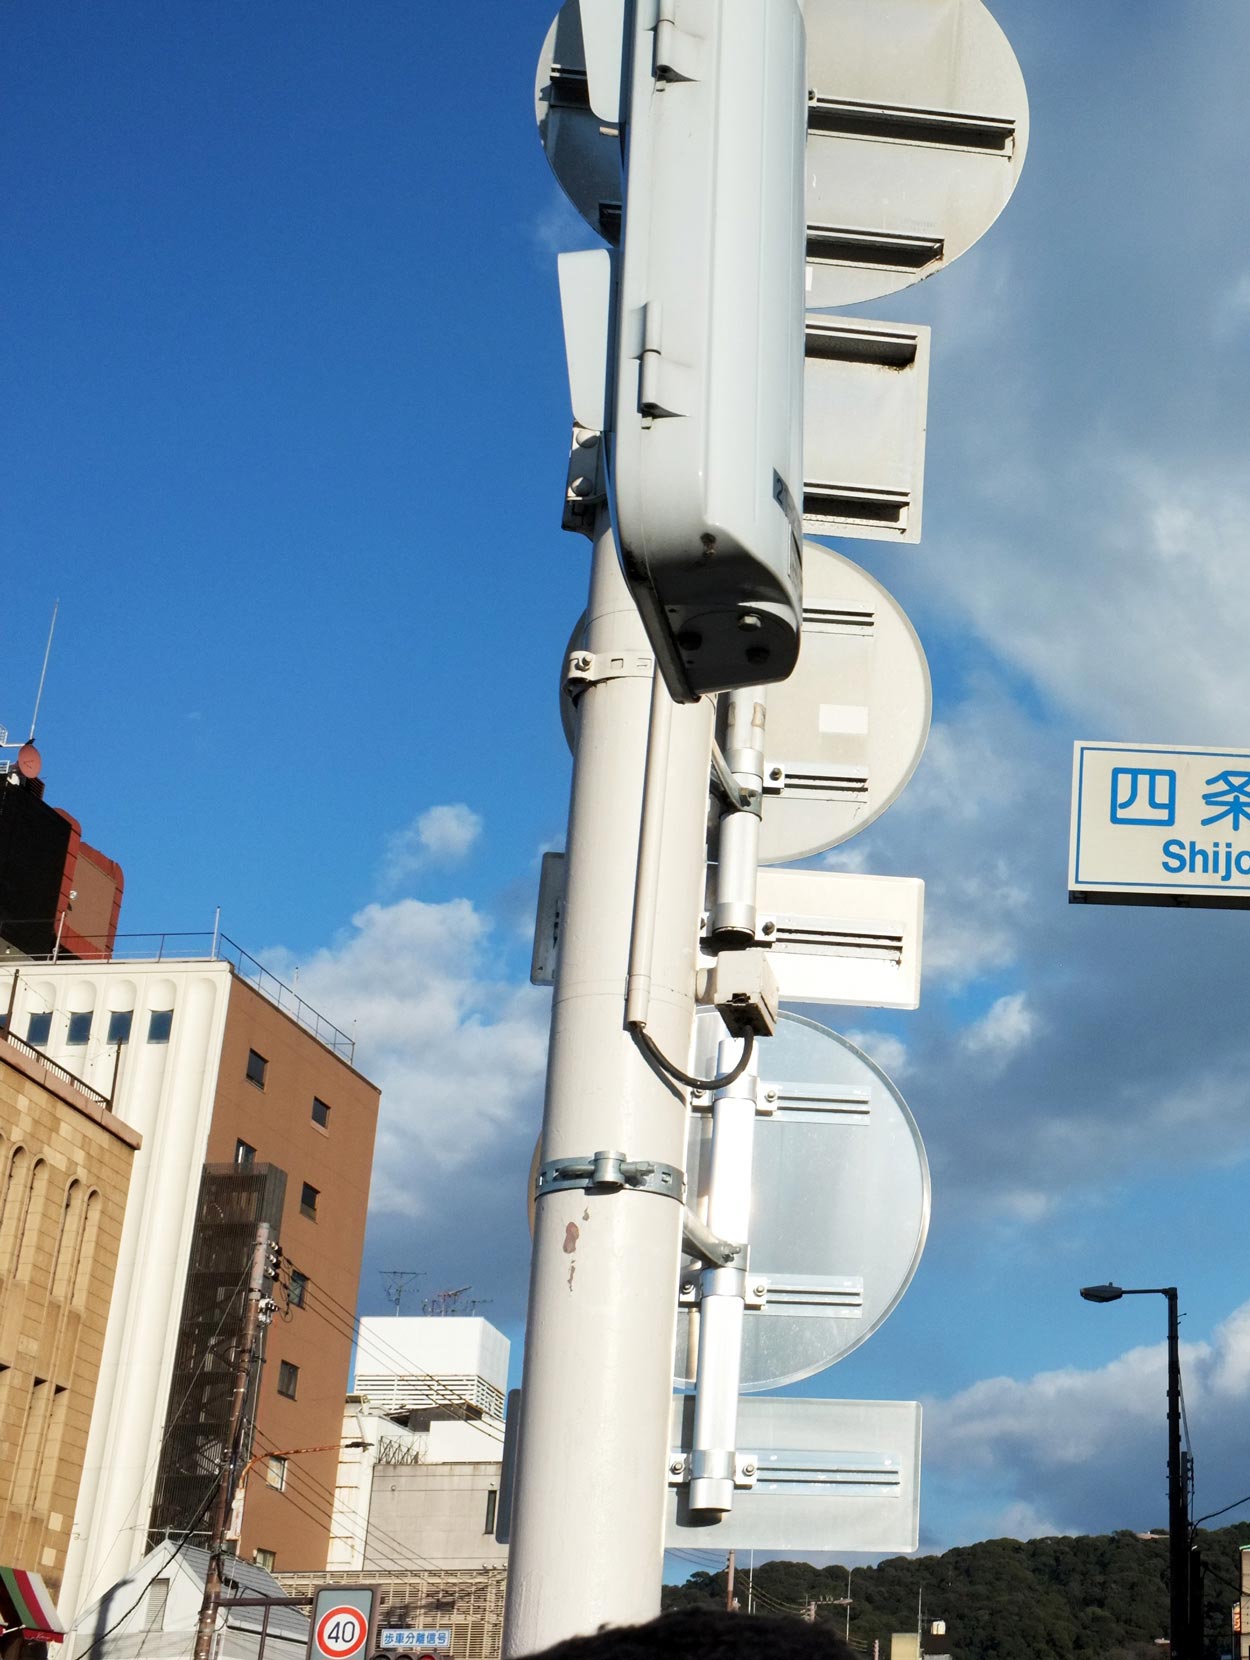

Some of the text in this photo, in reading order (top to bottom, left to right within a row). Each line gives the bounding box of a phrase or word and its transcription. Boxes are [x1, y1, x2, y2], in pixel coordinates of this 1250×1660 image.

[327, 1620, 356, 1644] 40
[384, 1632, 448, 1645] 歩車分離信号
